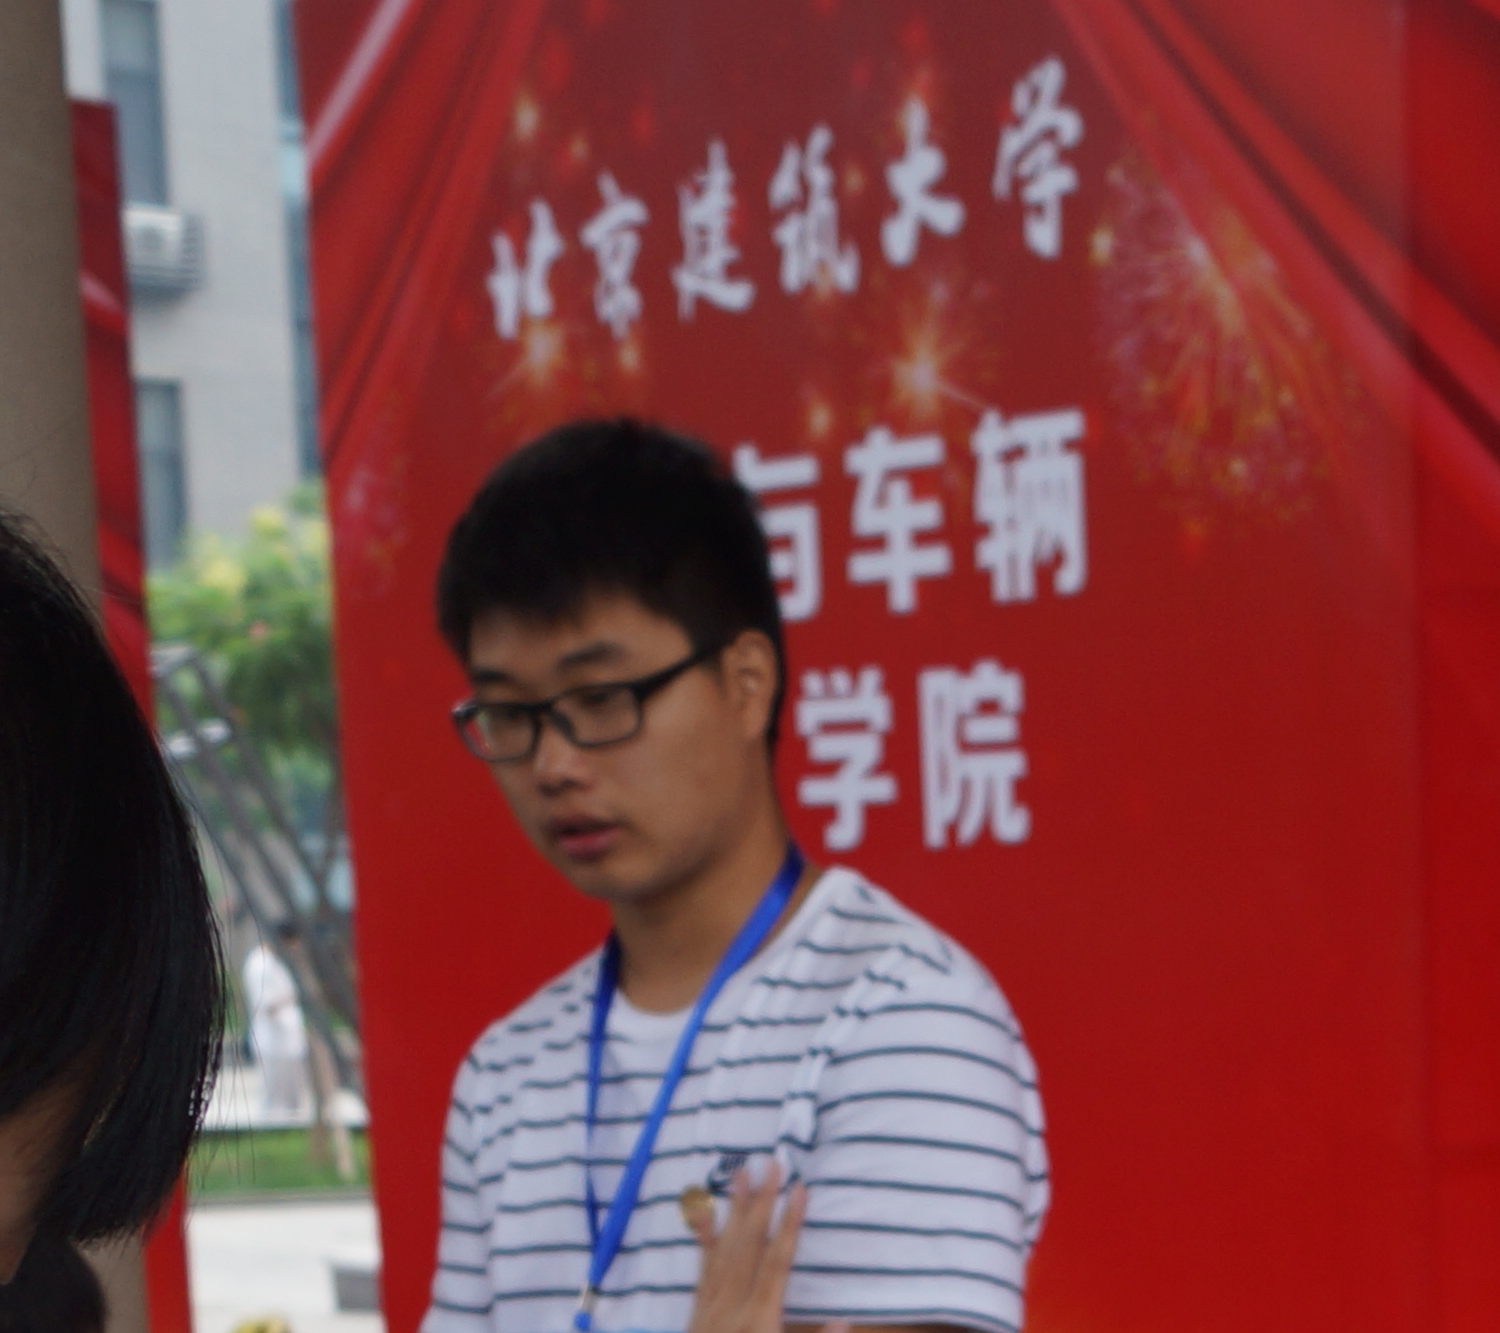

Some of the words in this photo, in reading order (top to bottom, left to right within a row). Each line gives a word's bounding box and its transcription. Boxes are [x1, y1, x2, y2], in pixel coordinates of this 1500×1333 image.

[487, 57, 1085, 340] 北京建筑大学
[794, 659, 1031, 851] 学院
